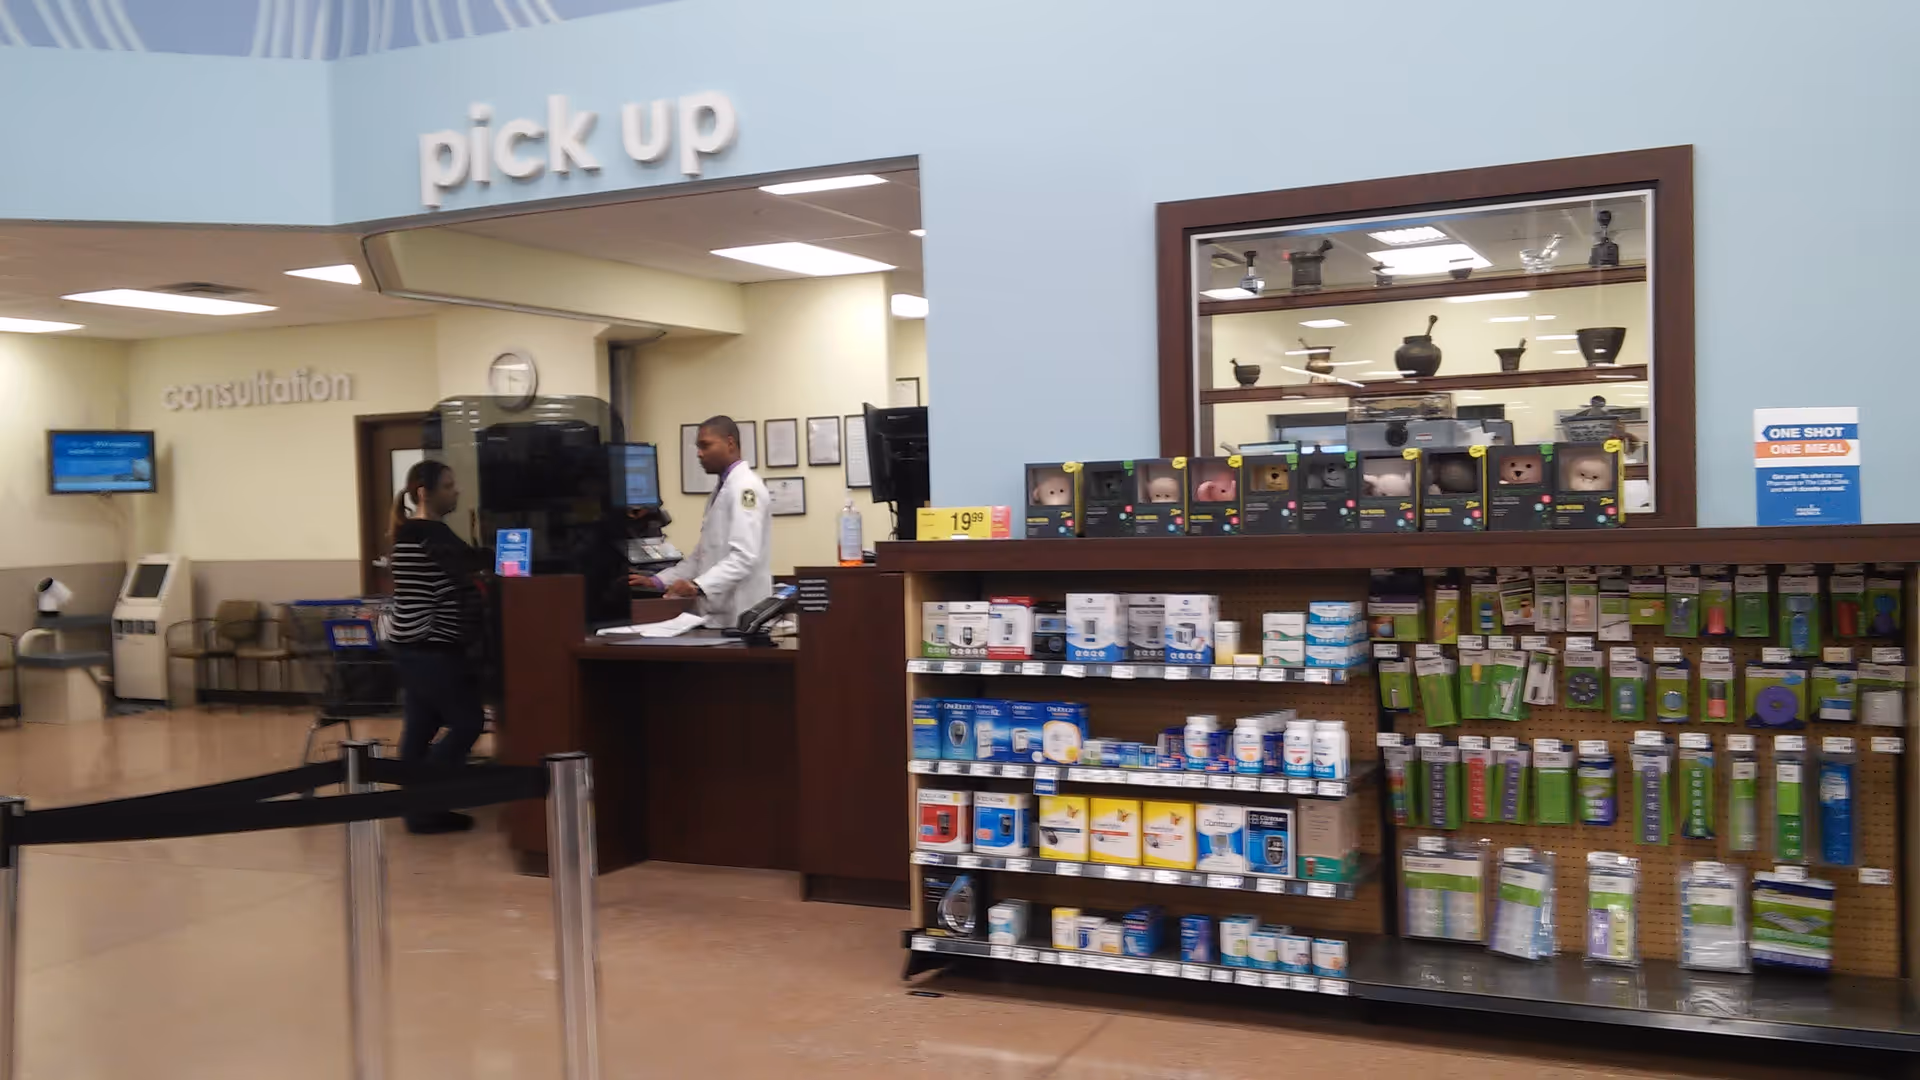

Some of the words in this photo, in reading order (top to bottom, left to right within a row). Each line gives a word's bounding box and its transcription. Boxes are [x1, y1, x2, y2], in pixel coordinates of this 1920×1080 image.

[418, 94, 602, 208] pick
[622, 91, 738, 176] up
[161, 369, 354, 410] consultation
[1769, 428, 1801, 439] ONE
[1804, 427, 1844, 438] SHOT
[1770, 444, 1802, 454] ONE
[1805, 443, 1846, 454] MEAL
